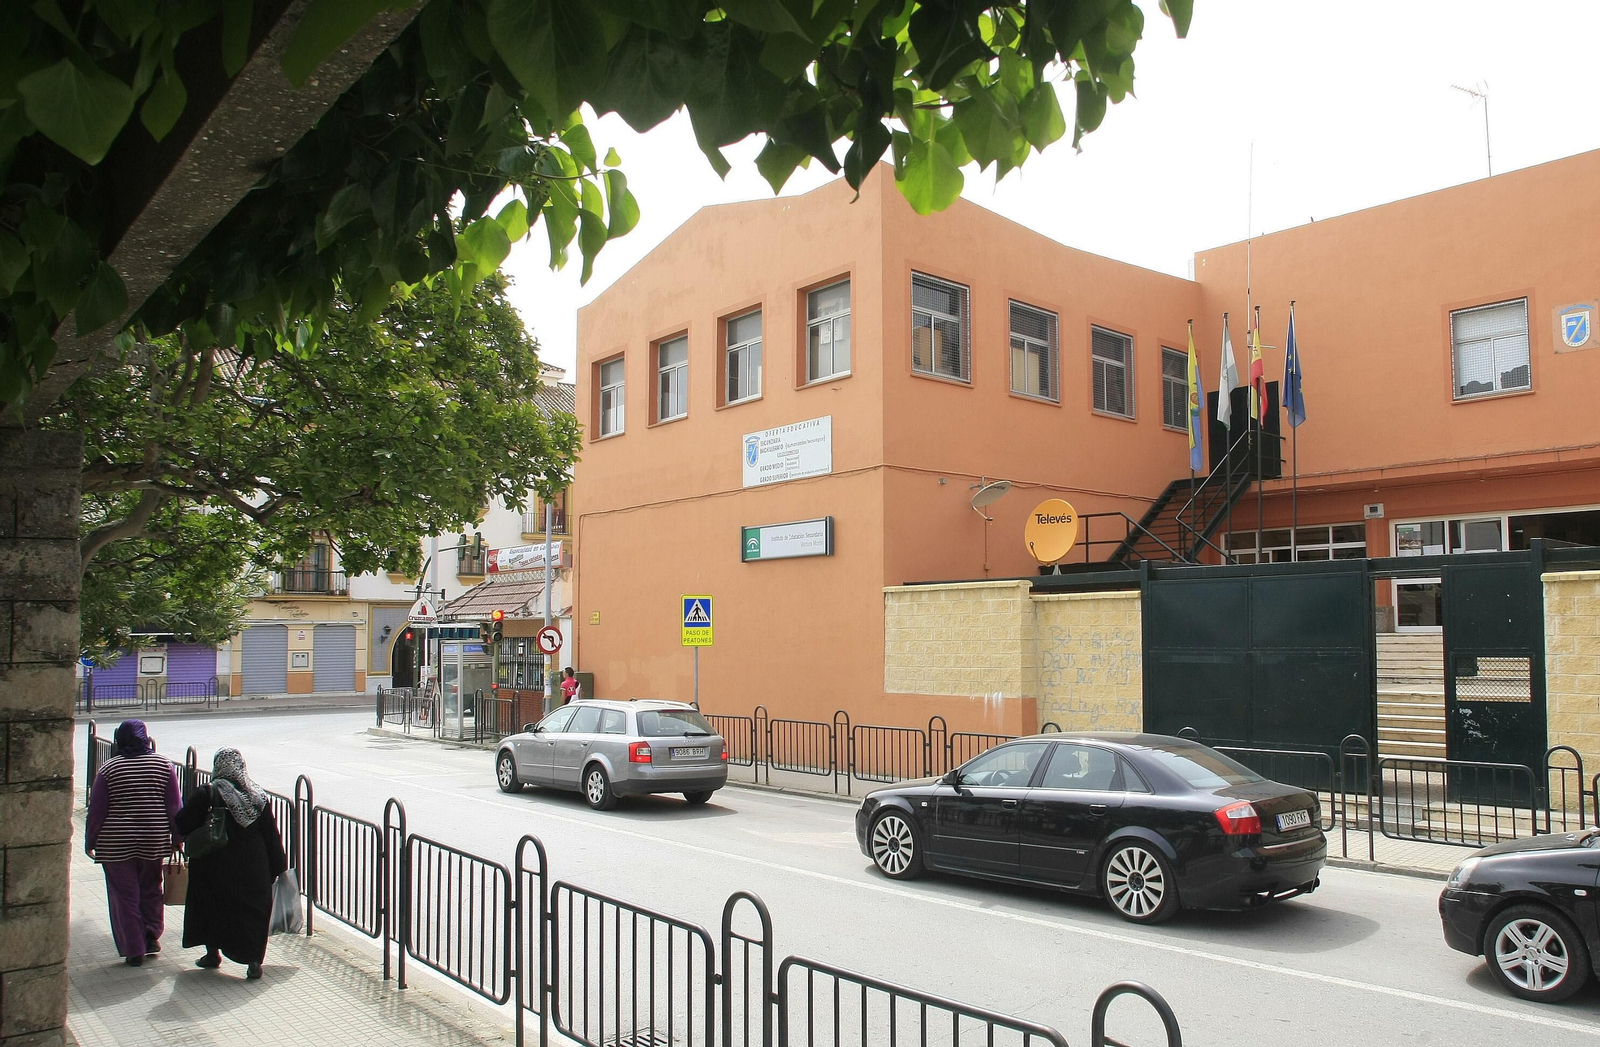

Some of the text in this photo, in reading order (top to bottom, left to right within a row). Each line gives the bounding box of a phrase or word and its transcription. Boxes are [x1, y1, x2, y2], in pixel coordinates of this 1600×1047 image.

[765, 420, 820, 437] OFERTA EDUCATIVA
[1035, 513, 1072, 524] Televés
[509, 546, 532, 554] Especialidad
[1282, 813, 1297, 827] 1090
